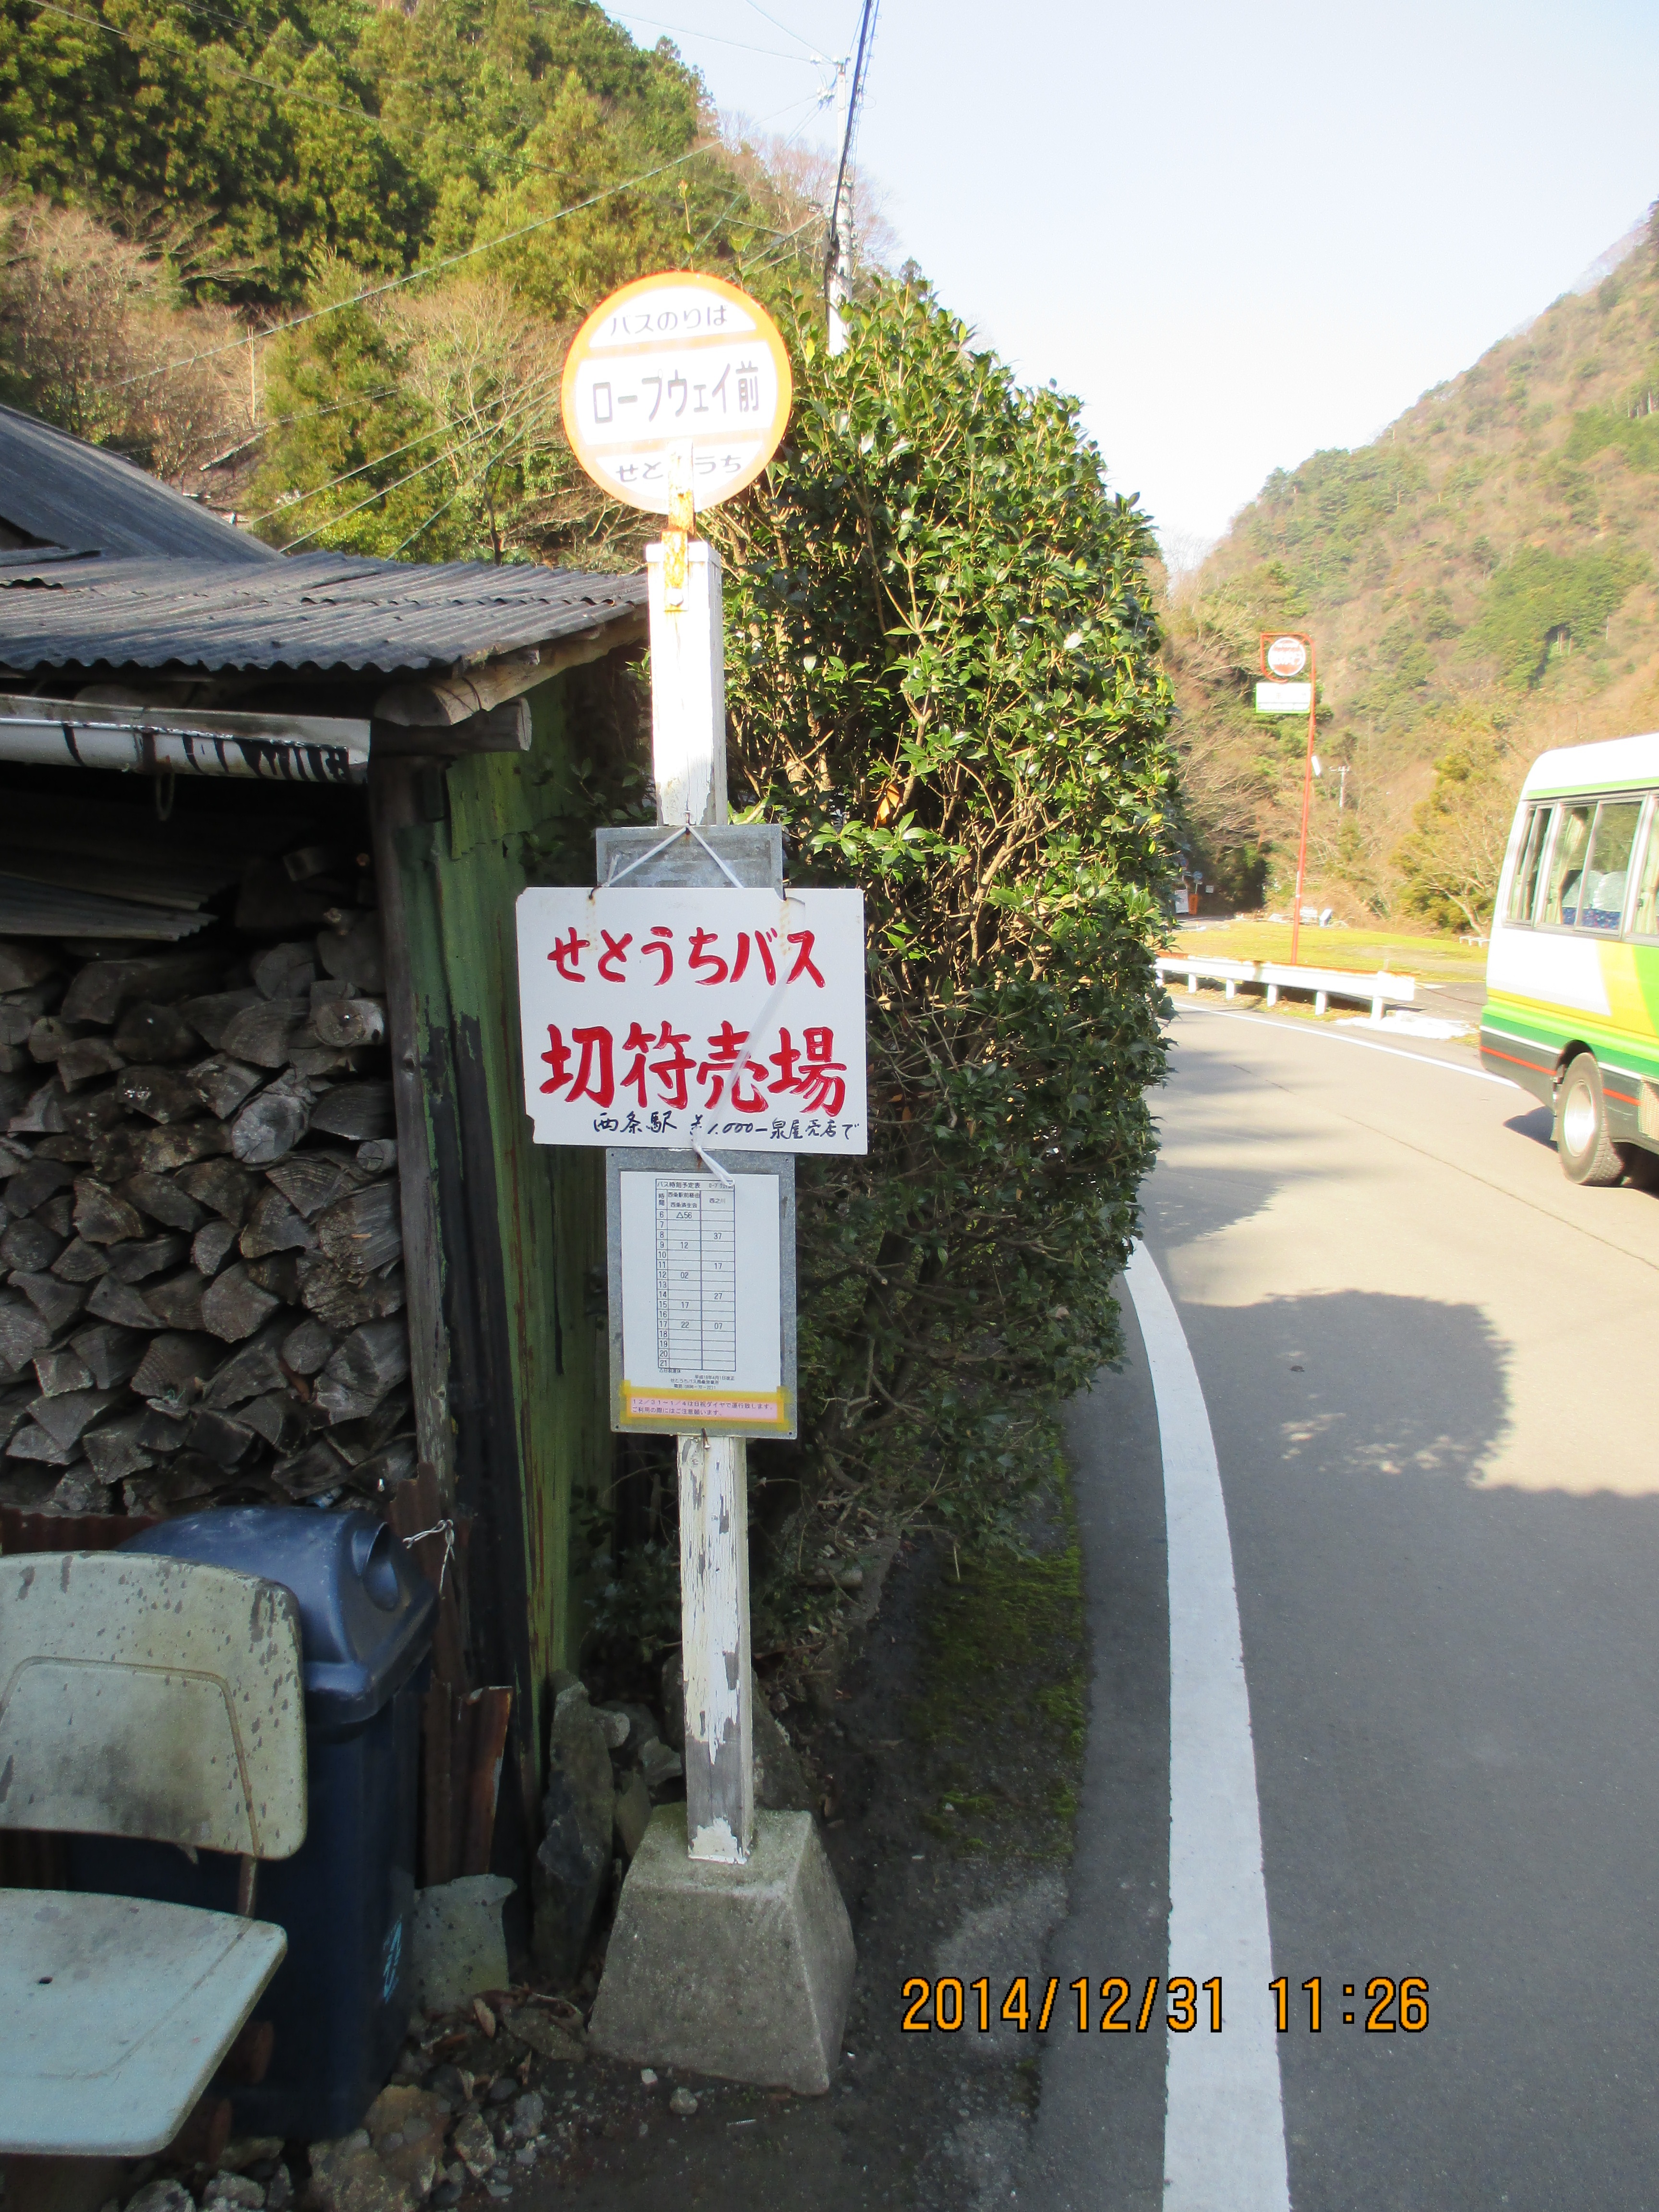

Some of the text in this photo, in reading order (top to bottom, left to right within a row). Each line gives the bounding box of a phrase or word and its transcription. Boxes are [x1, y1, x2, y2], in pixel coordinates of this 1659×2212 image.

[610, 304, 728, 337] バスのりば
[592, 361, 759, 424] ロープウェイ前
[547, 927, 825, 988] せとうちバス
[540, 1021, 847, 1117] 切符売場
[593, 1110, 678, 1134] 西条駅
